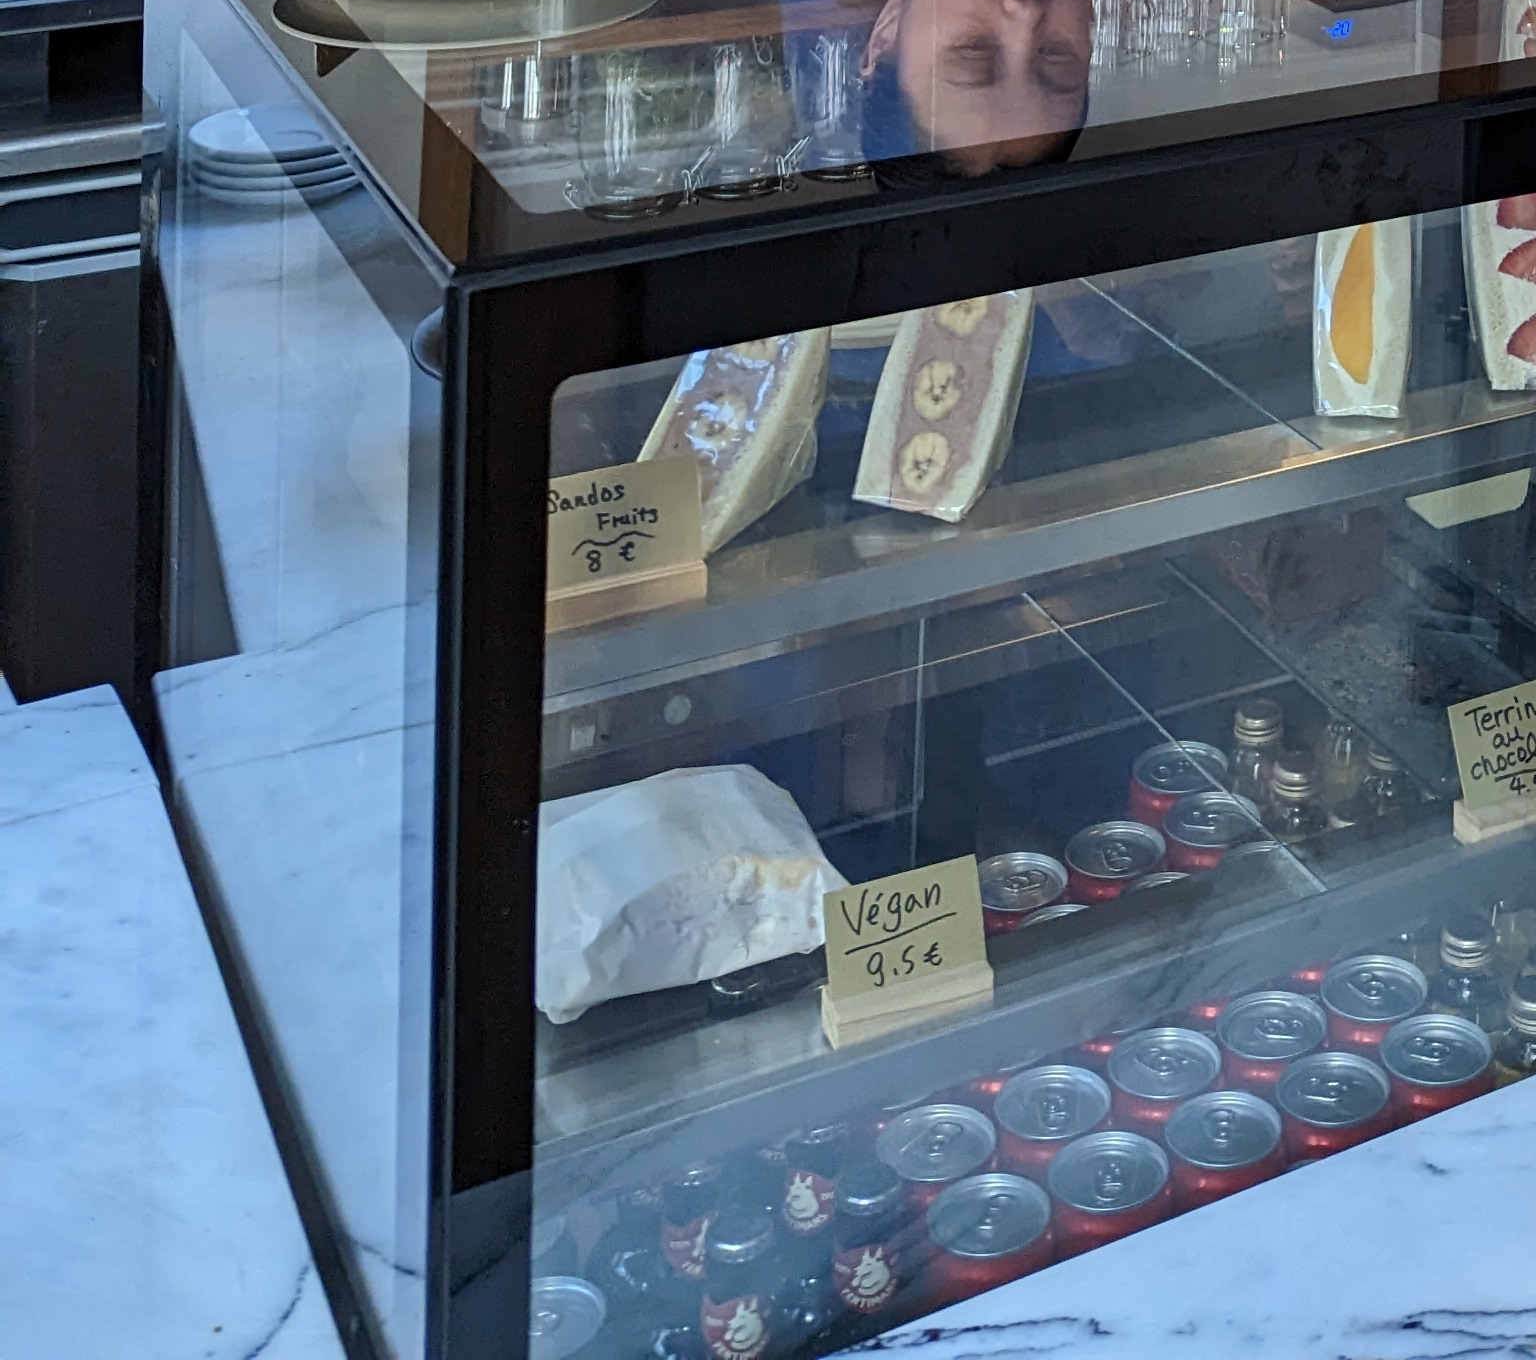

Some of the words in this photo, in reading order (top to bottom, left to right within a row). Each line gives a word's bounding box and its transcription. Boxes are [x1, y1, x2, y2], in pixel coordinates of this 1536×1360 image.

[596, 506, 659, 531] Fruits
[586, 549, 601, 573] 8
[1492, 726, 1524, 749] au
[840, 883, 941, 936] Végan
